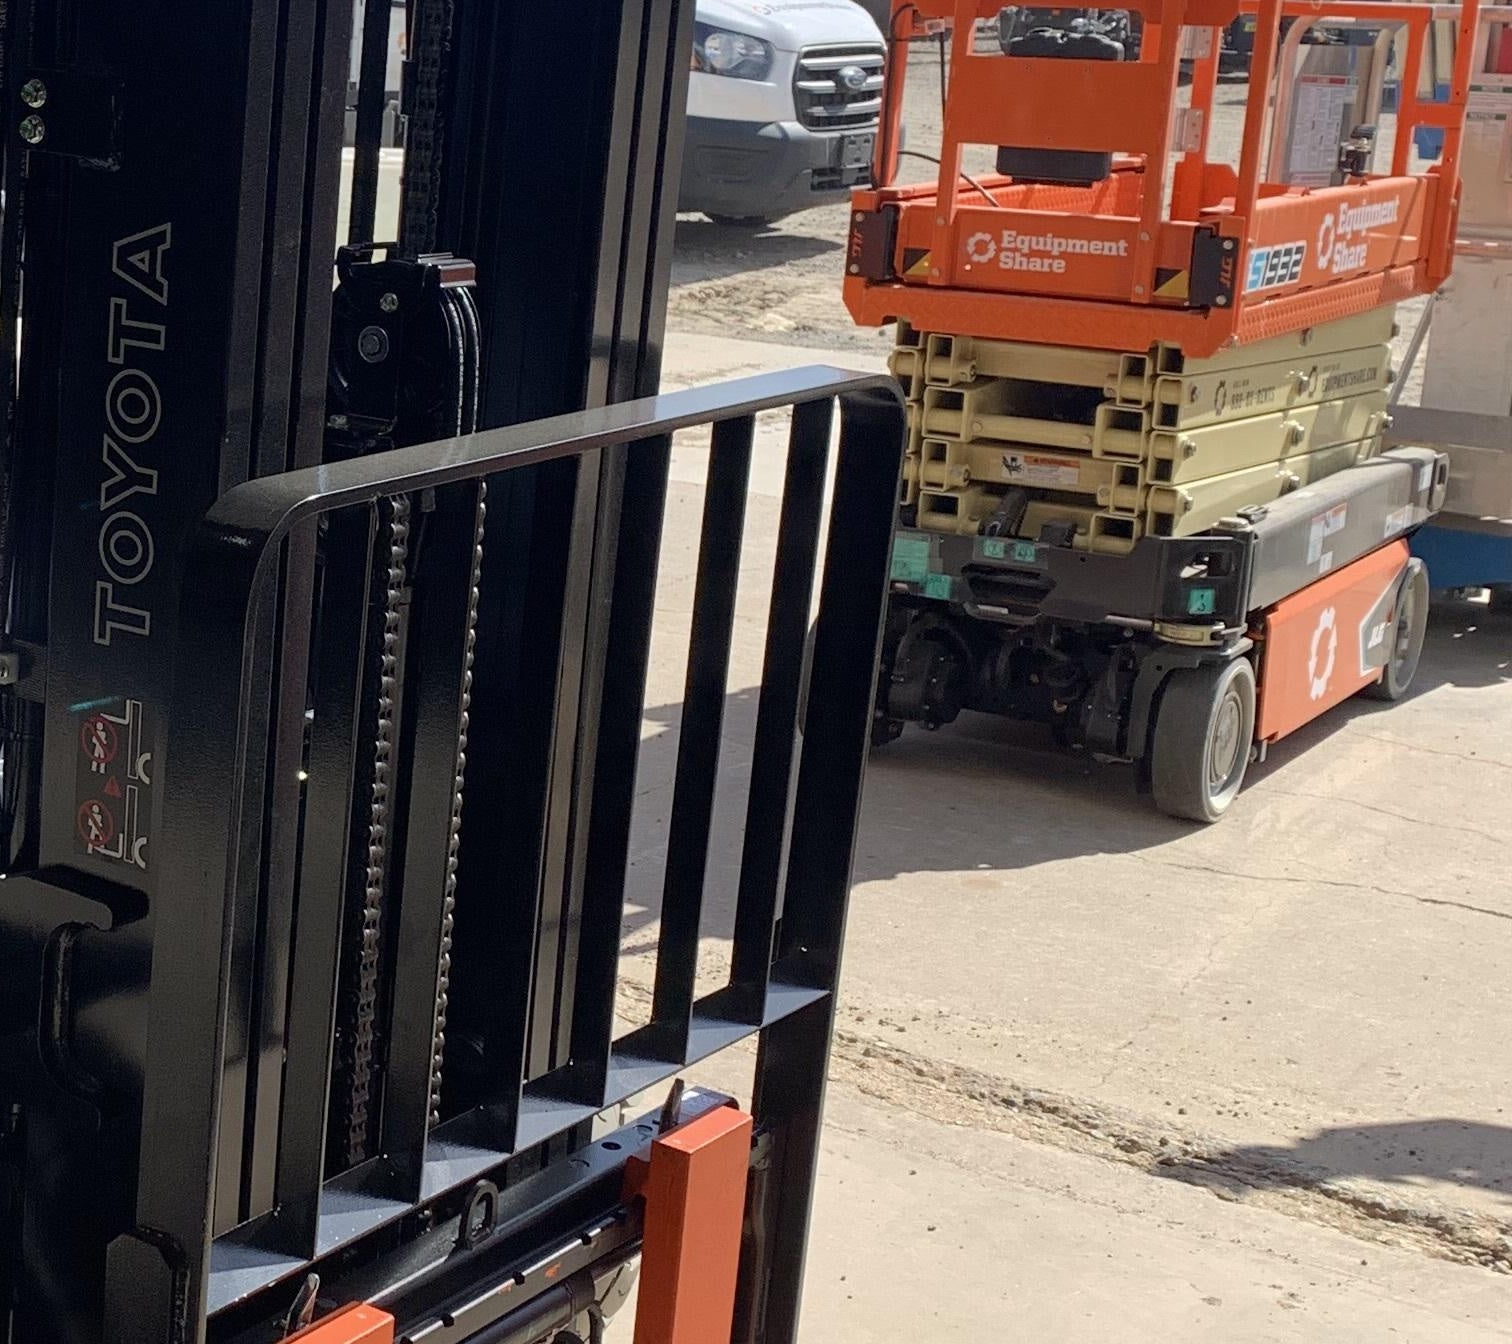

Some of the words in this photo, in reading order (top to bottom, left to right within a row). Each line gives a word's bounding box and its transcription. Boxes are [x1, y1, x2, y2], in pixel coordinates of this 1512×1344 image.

[1338, 195, 1400, 238] Equipment
[1001, 229, 1128, 256] Equipment
[1332, 242, 1368, 273] Share
[999, 251, 1066, 273] Share
[93, 221, 173, 646] TOYOTA
